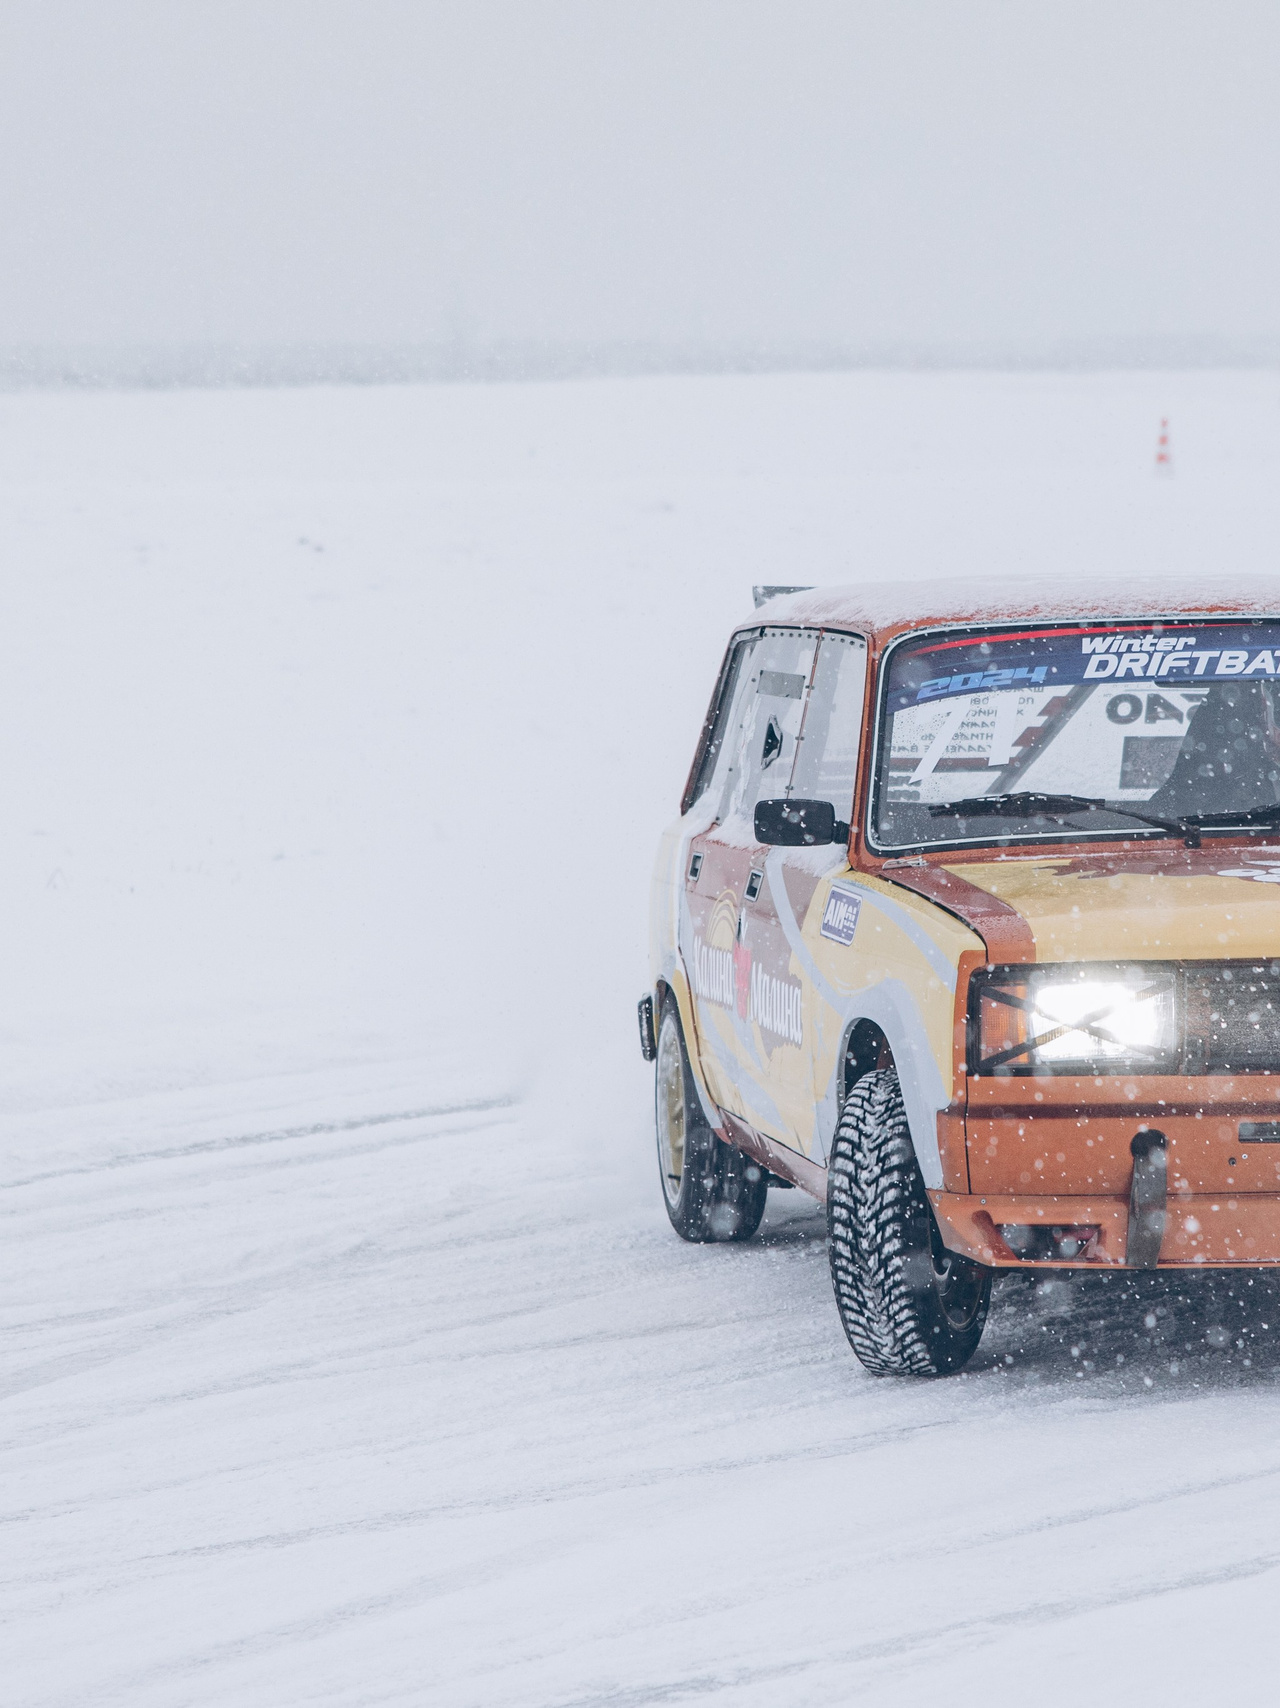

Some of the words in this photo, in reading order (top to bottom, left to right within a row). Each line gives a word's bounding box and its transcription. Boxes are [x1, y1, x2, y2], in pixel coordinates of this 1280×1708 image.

[1082, 634, 1196, 654] Winter
[916, 666, 1048, 700] 2024
[750, 961, 803, 1044] Малина
